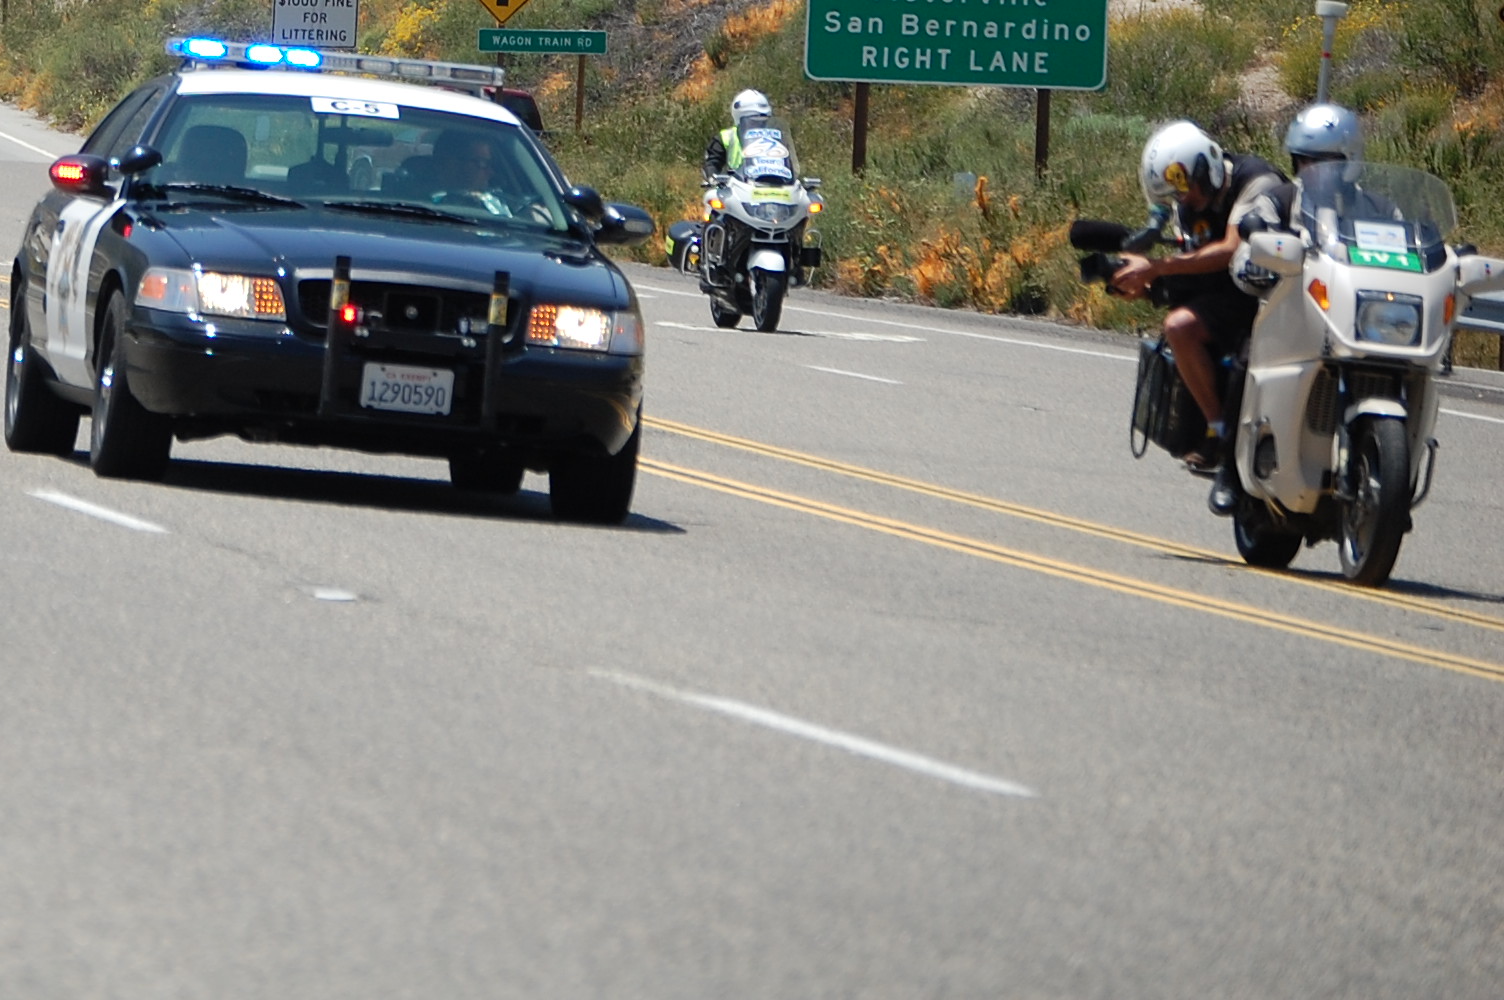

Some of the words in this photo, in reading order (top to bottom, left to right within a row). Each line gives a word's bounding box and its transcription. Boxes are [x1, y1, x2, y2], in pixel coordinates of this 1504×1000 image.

[303, 12, 327, 24] FOR
[824, 11, 883, 34] San
[901, 14, 1091, 42] Bernardino
[282, 28, 347, 42] LITTERING
[492, 35, 532, 46] WAGON
[538, 36, 572, 47] TRAIN
[577, 37, 593, 48] RD
[862, 46, 951, 70] RIGHT
[970, 51, 1049, 74] LANE
[1356, 250, 1391, 264] TV
[368, 380, 446, 408] 1290590
